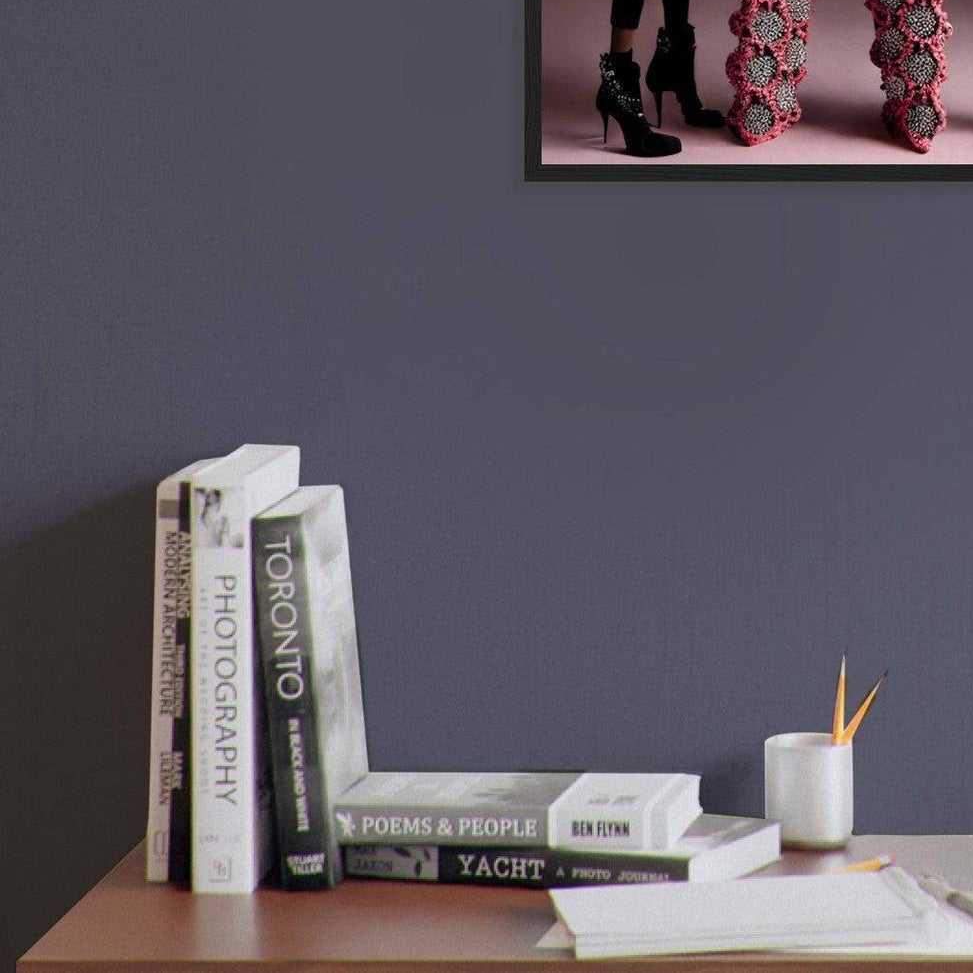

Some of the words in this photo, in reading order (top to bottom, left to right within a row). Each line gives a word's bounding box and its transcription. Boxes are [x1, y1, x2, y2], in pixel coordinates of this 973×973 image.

[163, 532, 178, 599] MODERN
[177, 531, 191, 618] ANALYSING
[265, 534, 304, 701] TORONTO
[160, 603, 177, 715] ARCHITECTURE
[214, 575, 238, 805] PHOTOGRAPHY
[362, 816, 433, 836] POEMS
[436, 817, 453, 836] &
[458, 817, 538, 837] PEOPLE
[571, 820, 593, 837] BEN
[597, 820, 630, 837] FLYNN
[457, 854, 545, 880] YACHT
[556, 867, 565, 877] A
[572, 867, 612, 881] PHOTO
